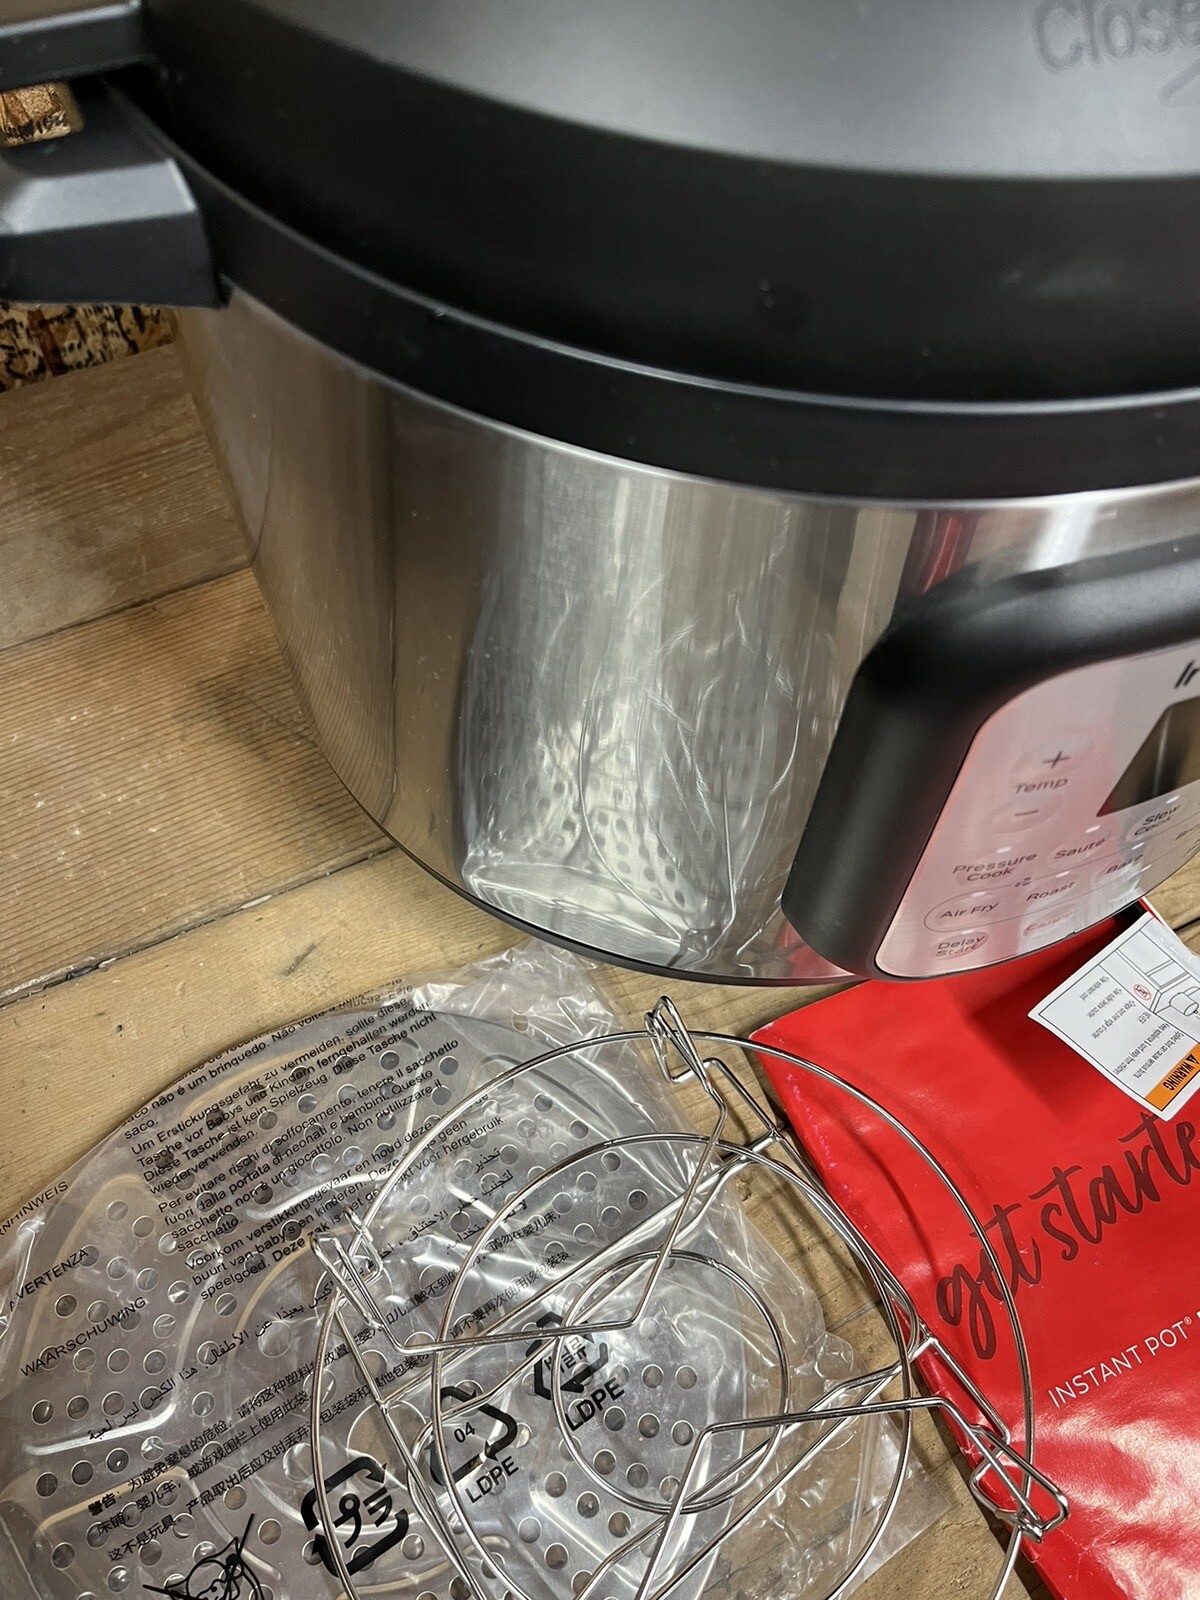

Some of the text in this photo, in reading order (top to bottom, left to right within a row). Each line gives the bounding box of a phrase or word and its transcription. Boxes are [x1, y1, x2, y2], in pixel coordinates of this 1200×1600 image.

[1015, 776, 1068, 796] Temp
[1143, 804, 1181, 825] Slow
[952, 853, 1037, 874] Pressure
[967, 867, 1014, 881] Cook
[1026, 881, 1077, 901] Roast
[938, 935, 985, 950] Delay
[940, 903, 999, 919] Air Fry
[935, 945, 978, 957] Start
[130, 1136, 155, 1155] Um
[156, 1077, 262, 1142] Erstickungsgefahr
[263, 1067, 278, 1081] zu
[280, 1032, 344, 1072] vermeiden,
[344, 1013, 375, 1037] sollte
[376, 995, 408, 1019] diese
[137, 997, 432, 1169] Tasche vor Babys und Kindern ferngehalten werden.
[142, 1011, 437, 1182] Diese Tasche ist kein Spielzeug. Diese Tasche nicht
[150, 1091, 175, 1110] não
[175, 1084, 185, 1095] é
[187, 1074, 207, 1089] um
[208, 1038, 270, 1078] brinquedo.
[1161, 1060, 1194, 1092] WARNING
[123, 1115, 158, 1139] saco.
[157, 1037, 459, 1213] Per evitare rischi di soffocamento, tenere il sacchetto
[164, 1067, 433, 1227] fuori dalla portata di neonati e bambini. Questo
[148, 1126, 258, 1195] wiederverwenden.
[170, 1202, 233, 1240] sacchetto
[258, 1178, 269, 1190] è
[286, 1131, 346, 1176] giocattolo.
[347, 1116, 373, 1136] Non
[374, 1083, 433, 1120] riutilizzare
[433, 1078, 442, 1088] il
[185, 1236, 243, 1271] Voorkom
[245, 1168, 353, 1241] verstikkingsgevaar
[353, 1158, 370, 1173] en
[371, 1137, 402, 1162] houd
[403, 1120, 432, 1144] deze
[191, 1261, 227, 1285] buurt
[229, 1249, 254, 1268] van
[254, 1223, 296, 1254] baby's
[297, 1213, 314, 1228] en
[314, 1177, 367, 1217] kinderen.
[437, 1118, 467, 1142] geen
[199, 1257, 270, 1300] speelgoed.
[271, 1236, 306, 1261] Deze
[329, 1212, 341, 1224] is
[414, 1150, 441, 1171] voor
[442, 1113, 505, 1155] hergebruik.
[176, 1214, 243, 1252] sacchetto.
[9, 1249, 89, 1312] AVERTENZA
[936, 1204, 1041, 1360] got
[20, 1297, 146, 1376] WAARSCHUWING
[565, 1378, 626, 1432] LDPE
[1048, 1345, 1140, 1408] INSTANT
[453, 1422, 476, 1444] 04
[465, 1456, 519, 1503] LDPE
